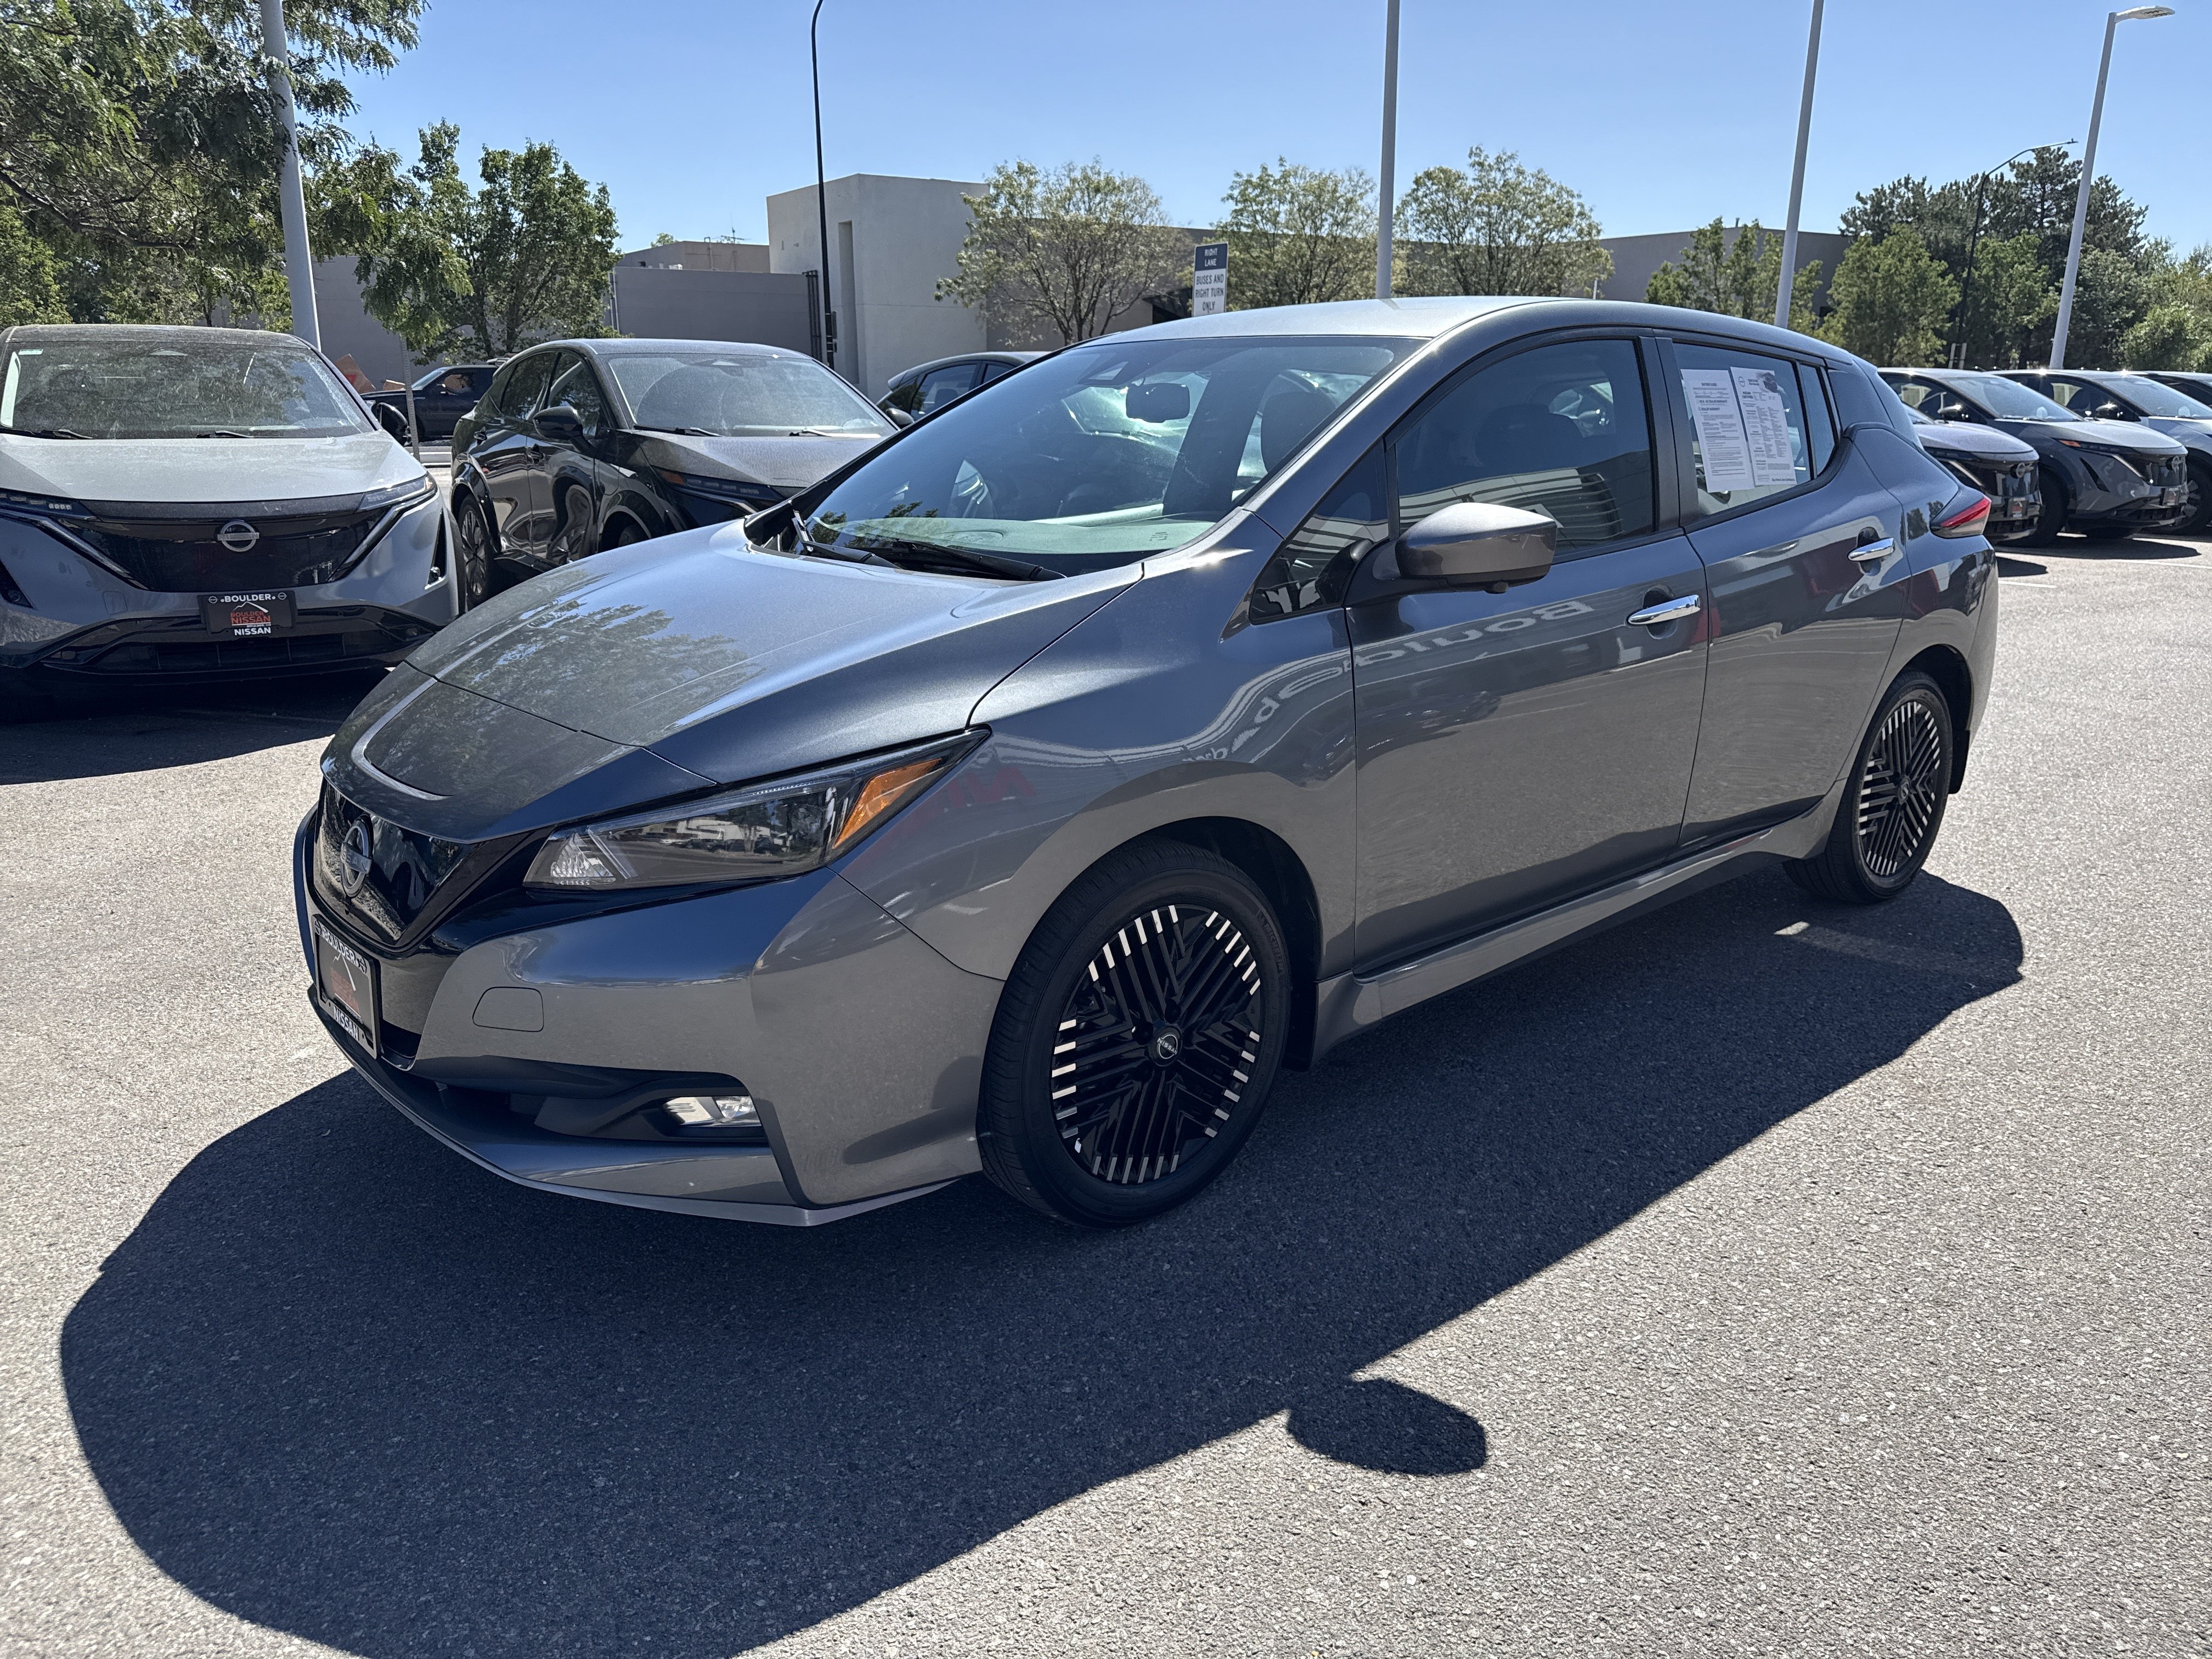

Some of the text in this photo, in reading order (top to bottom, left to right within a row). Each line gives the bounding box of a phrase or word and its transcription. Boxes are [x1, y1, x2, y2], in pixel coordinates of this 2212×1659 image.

[1204, 248, 1218, 256] RIGHT
[1204, 258, 1217, 267] LANE
[1197, 274, 1224, 285] BUSES AND
[1195, 287, 1224, 298] RIGHT TURN
[1202, 301, 1216, 311] ONLY
[231, 616, 270, 624] NISSAN
[234, 627, 271, 636] NISSAN
[334, 1006, 360, 1041] NISSAN
[1157, 1037, 1178, 1055] NISSAN
